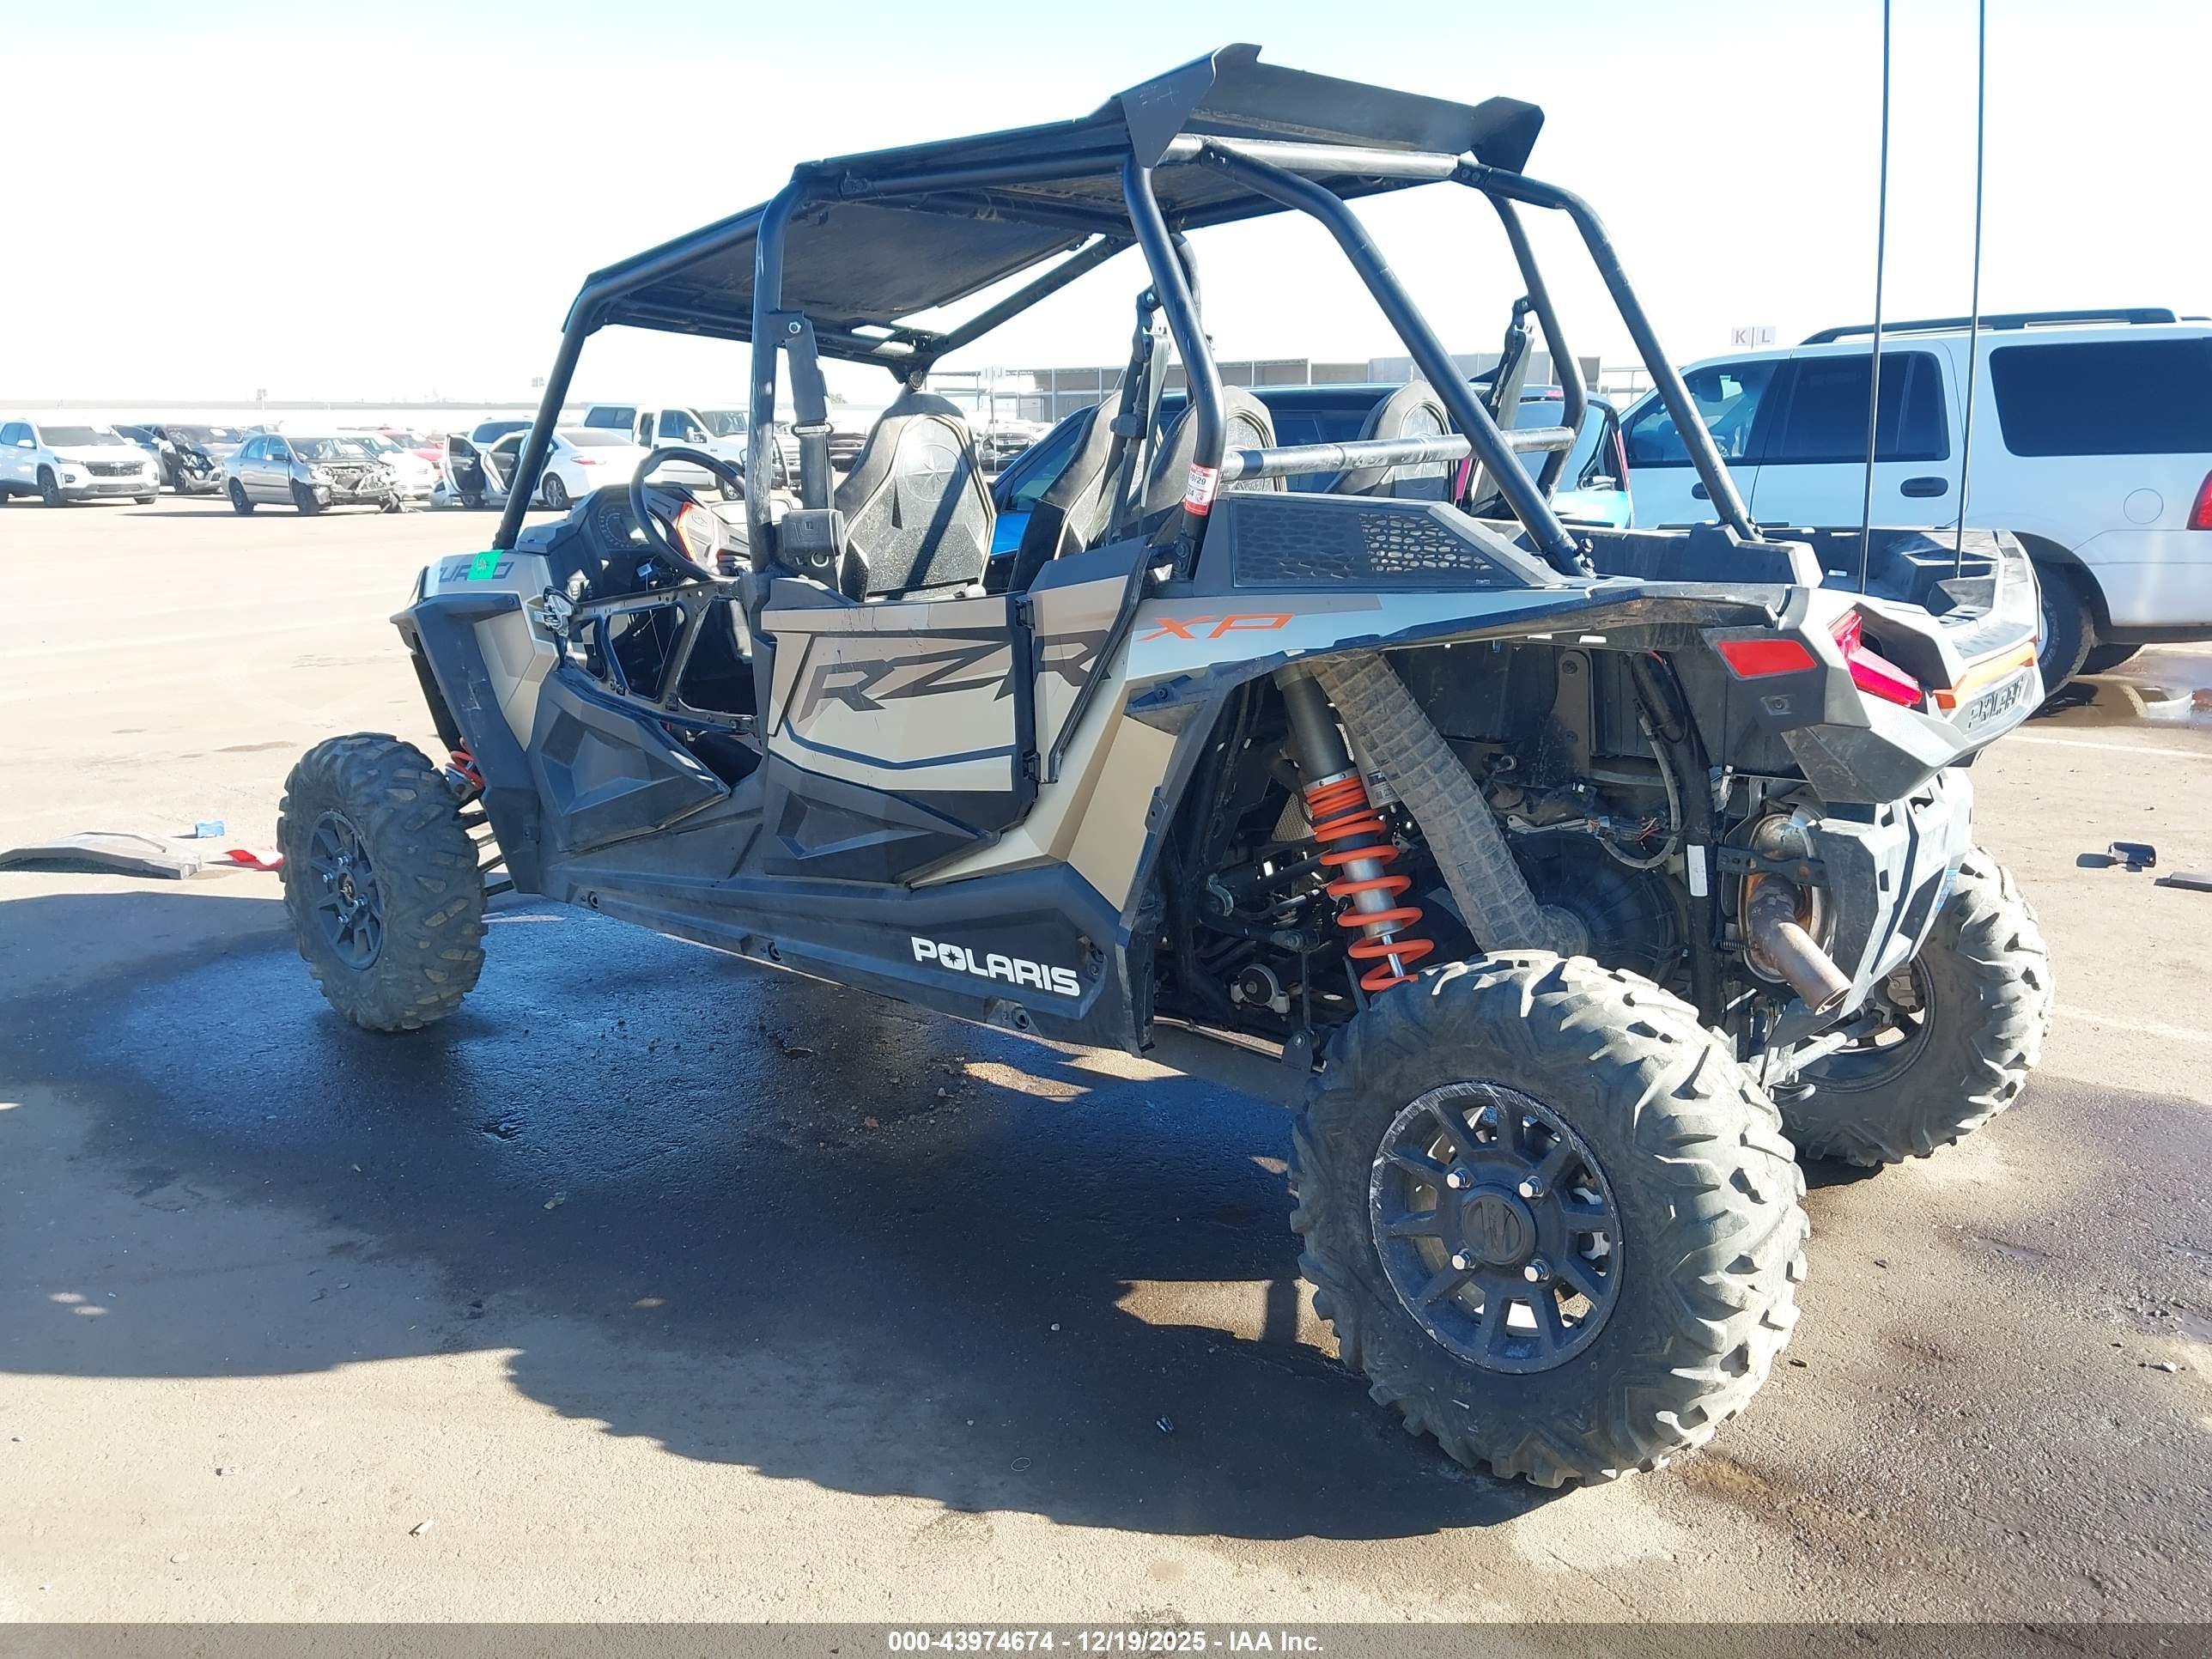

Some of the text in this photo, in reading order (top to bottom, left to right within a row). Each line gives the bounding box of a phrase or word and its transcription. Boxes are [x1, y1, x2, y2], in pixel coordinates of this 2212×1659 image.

[1735, 330, 1747, 344] K
[1761, 329, 1771, 343] L
[1138, 612, 1295, 642] XP
[797, 629, 1112, 723] RZR
[910, 936, 1080, 997] POLARIS
